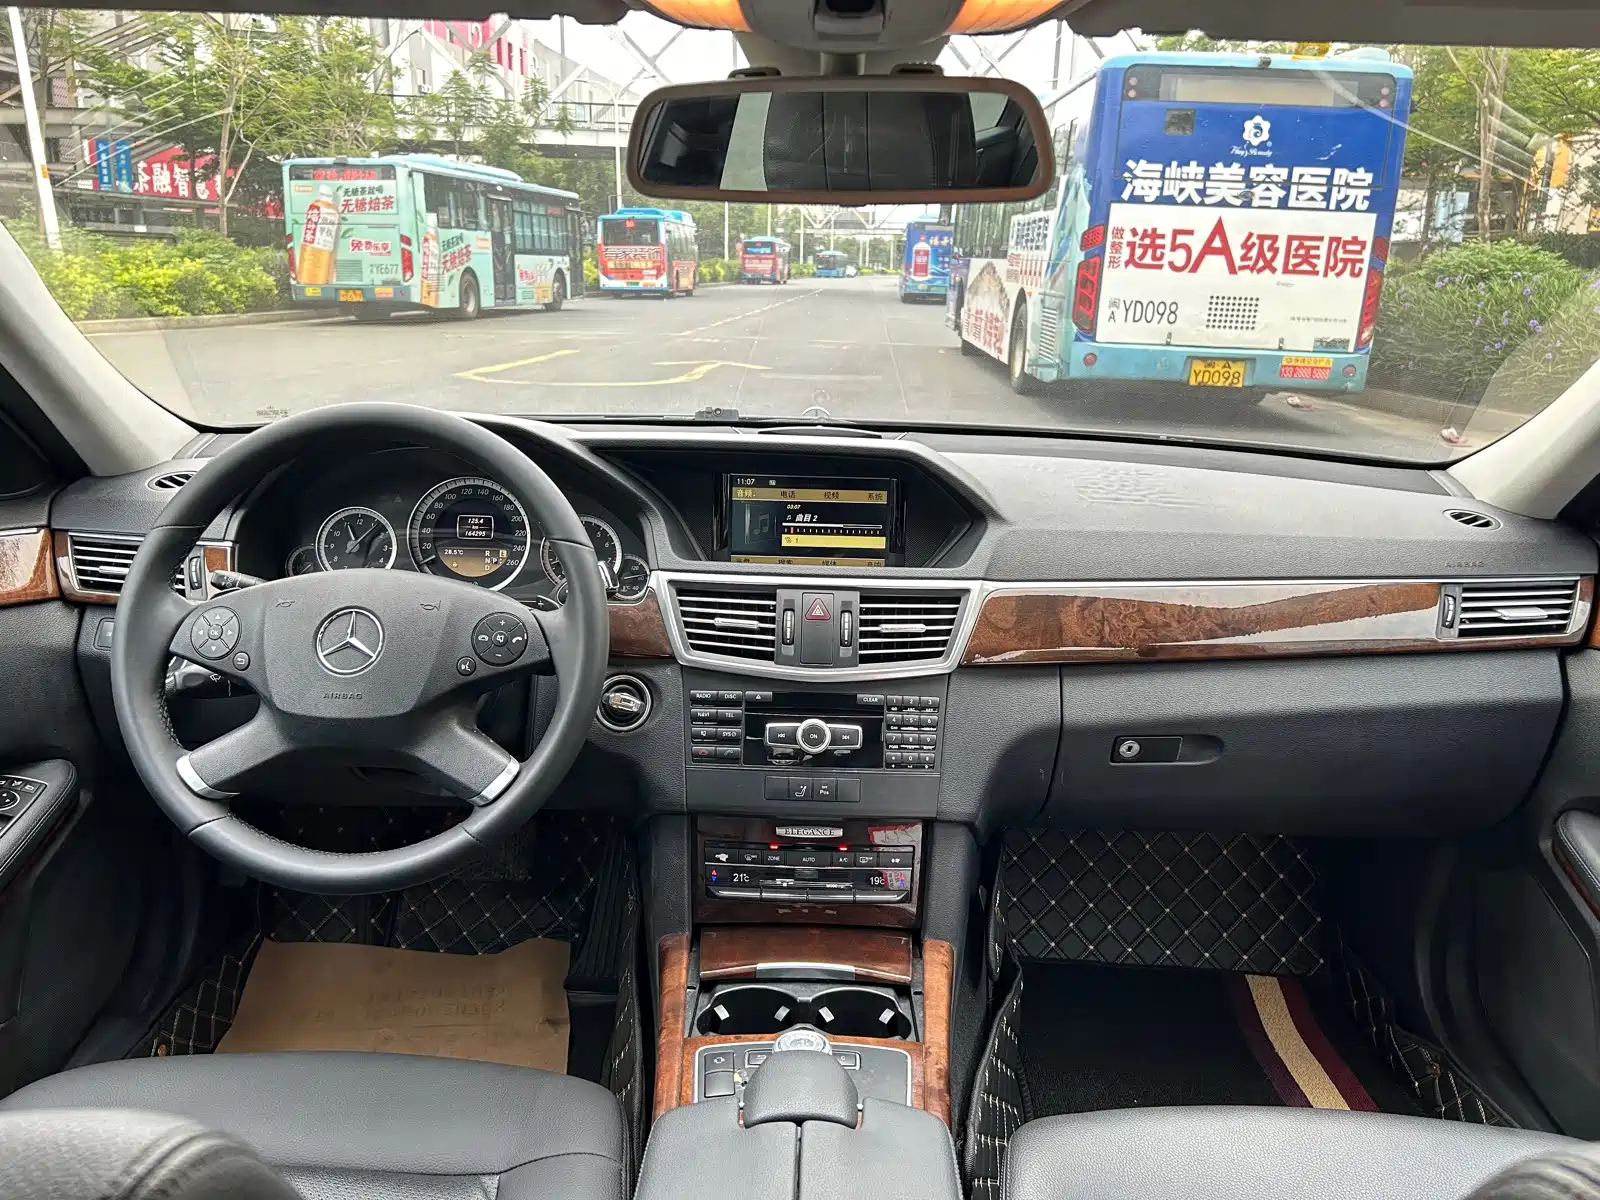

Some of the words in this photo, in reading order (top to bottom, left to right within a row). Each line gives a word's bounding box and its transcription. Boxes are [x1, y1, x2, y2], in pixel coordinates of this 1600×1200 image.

[1120, 159, 1374, 212] 海峡美容医院
[1108, 226, 1125, 270] 做整形
[1124, 215, 1368, 279] 选5A级医院
[1123, 299, 1179, 325] YD098
[1193, 369, 1241, 385] YD098
[477, 488, 489, 496] 140
[780, 490, 796, 499] 电话
[823, 491, 840, 500] 视频
[867, 492, 883, 501] 系统
[503, 503, 515, 511] 180
[795, 513, 811, 522] 曲目
[812, 514, 818, 522] 2
[514, 529, 527, 537] 220
[323, 692, 363, 700] AIRBAG
[784, 827, 835, 835] ELEGANCE
